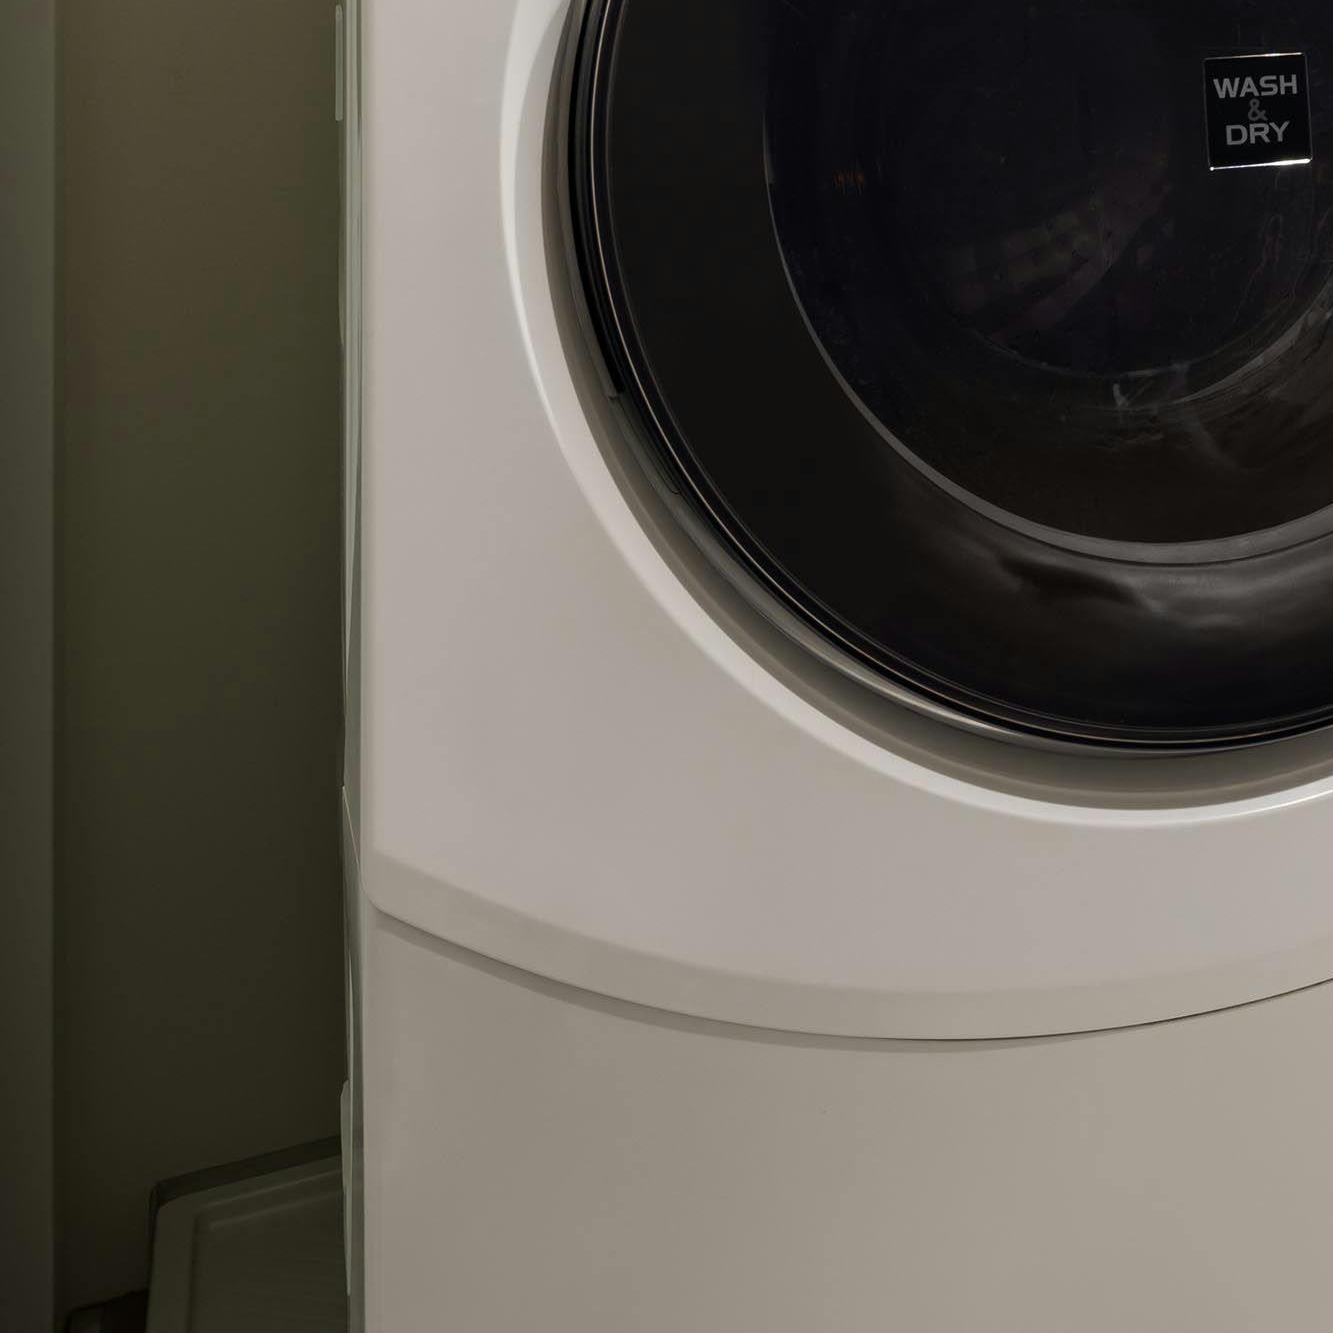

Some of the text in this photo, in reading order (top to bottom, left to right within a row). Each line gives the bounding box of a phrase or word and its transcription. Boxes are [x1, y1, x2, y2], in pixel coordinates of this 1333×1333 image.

[1213, 74, 1298, 99] WASH
[1248, 98, 1268, 121] &
[1226, 121, 1290, 146] DRY
